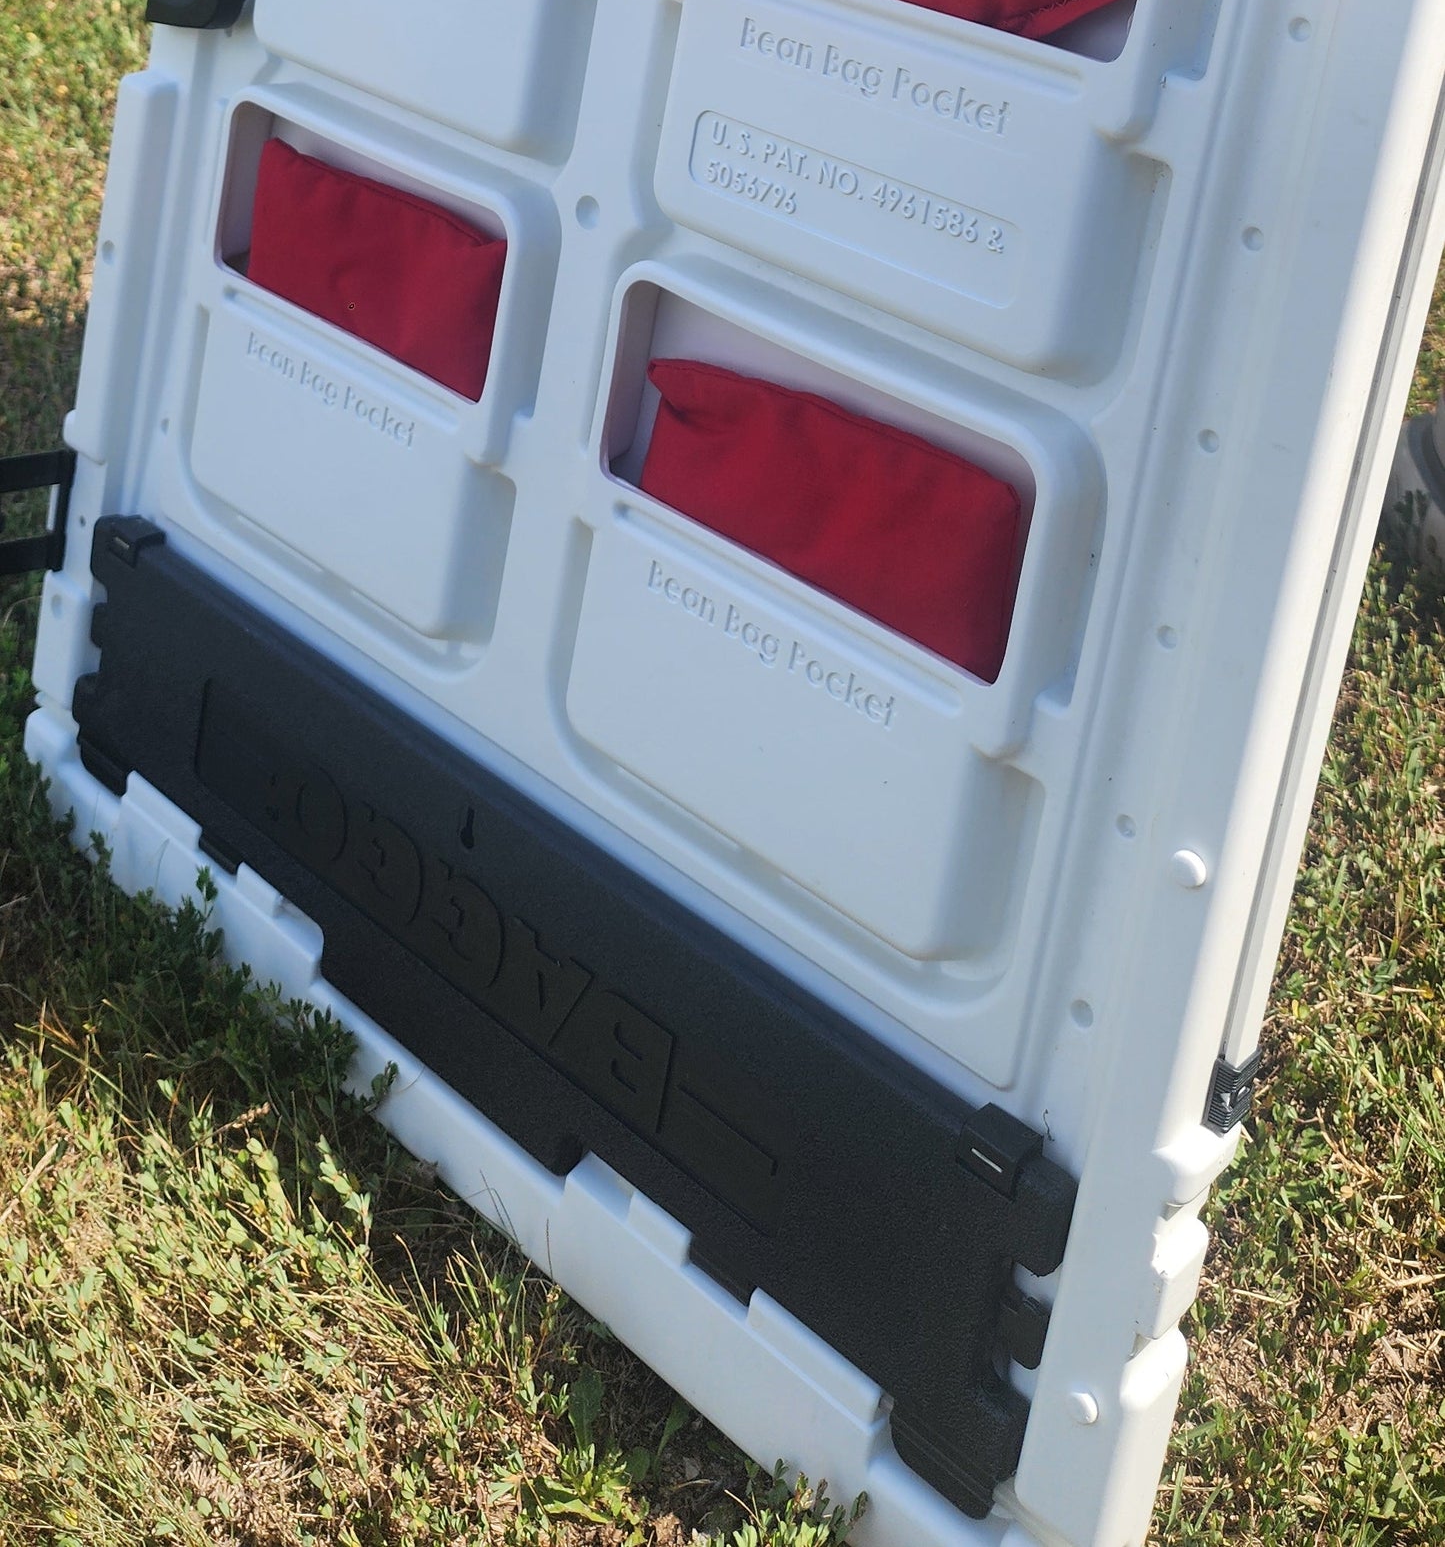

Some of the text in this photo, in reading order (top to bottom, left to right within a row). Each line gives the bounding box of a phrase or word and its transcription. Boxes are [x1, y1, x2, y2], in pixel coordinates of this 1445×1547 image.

[739, 16, 1010, 137] Bean Bag Pocket
[704, 159, 798, 215] 5056796
[712, 120, 1006, 255] U. S. PAT. NO. 4961586 &
[247, 331, 416, 449] Bean Bag Pocket
[647, 560, 897, 730] Bean Bag Pocket
